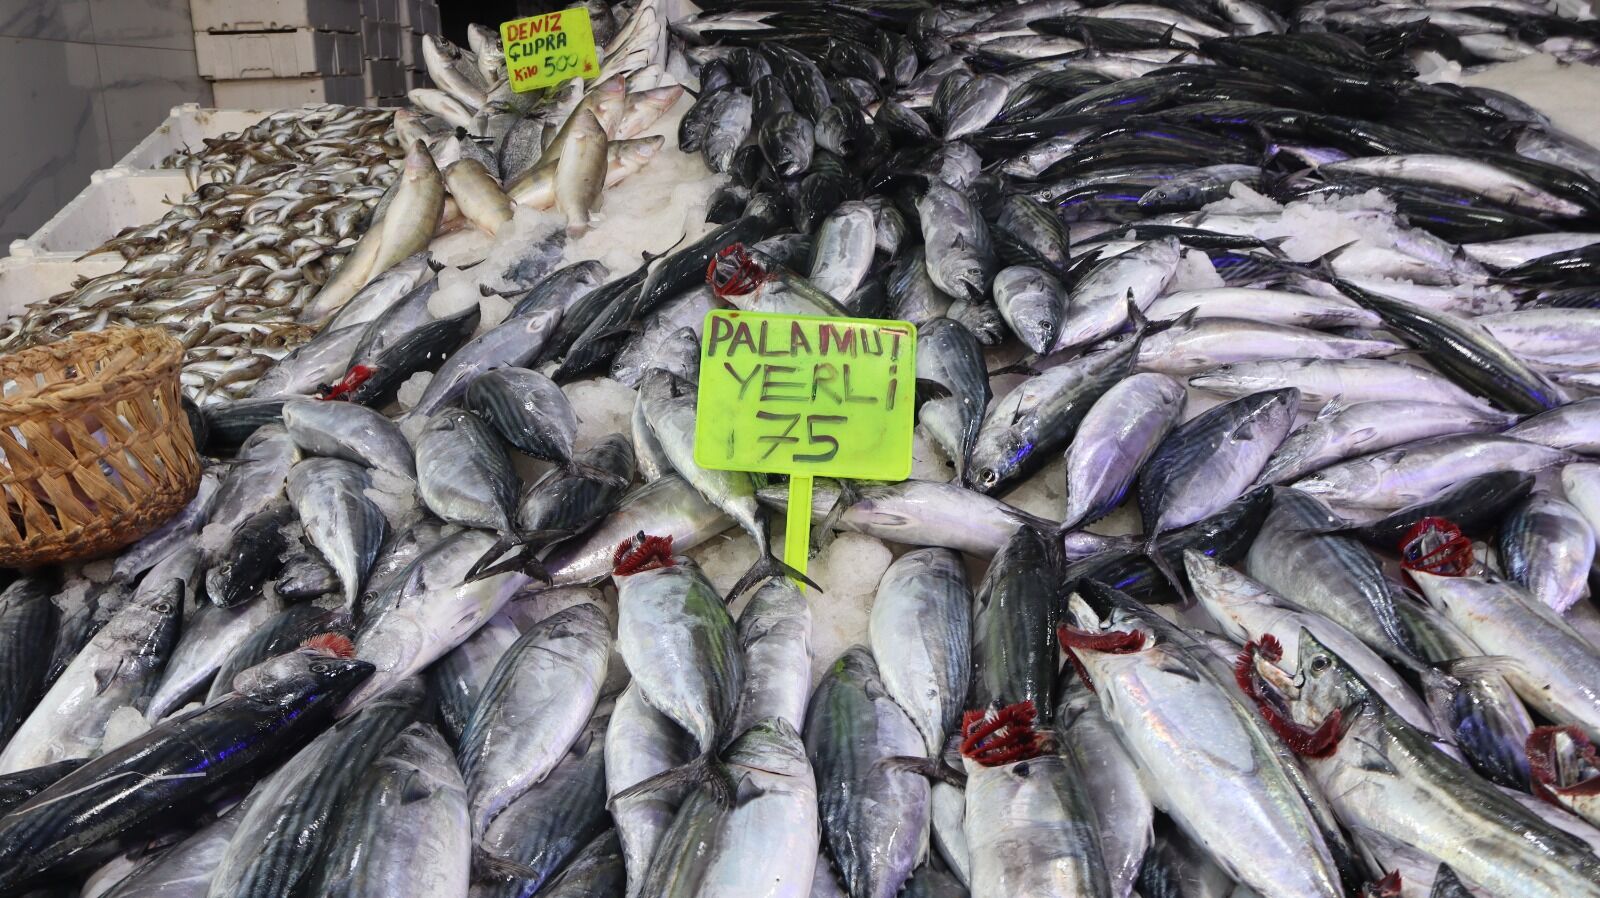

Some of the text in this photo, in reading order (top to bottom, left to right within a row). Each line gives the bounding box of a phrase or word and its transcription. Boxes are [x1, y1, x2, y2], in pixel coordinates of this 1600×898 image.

[508, 32, 567, 62] ÇUPRA
[544, 54, 579, 77] 500
[707, 316, 909, 361] PALAMUT
